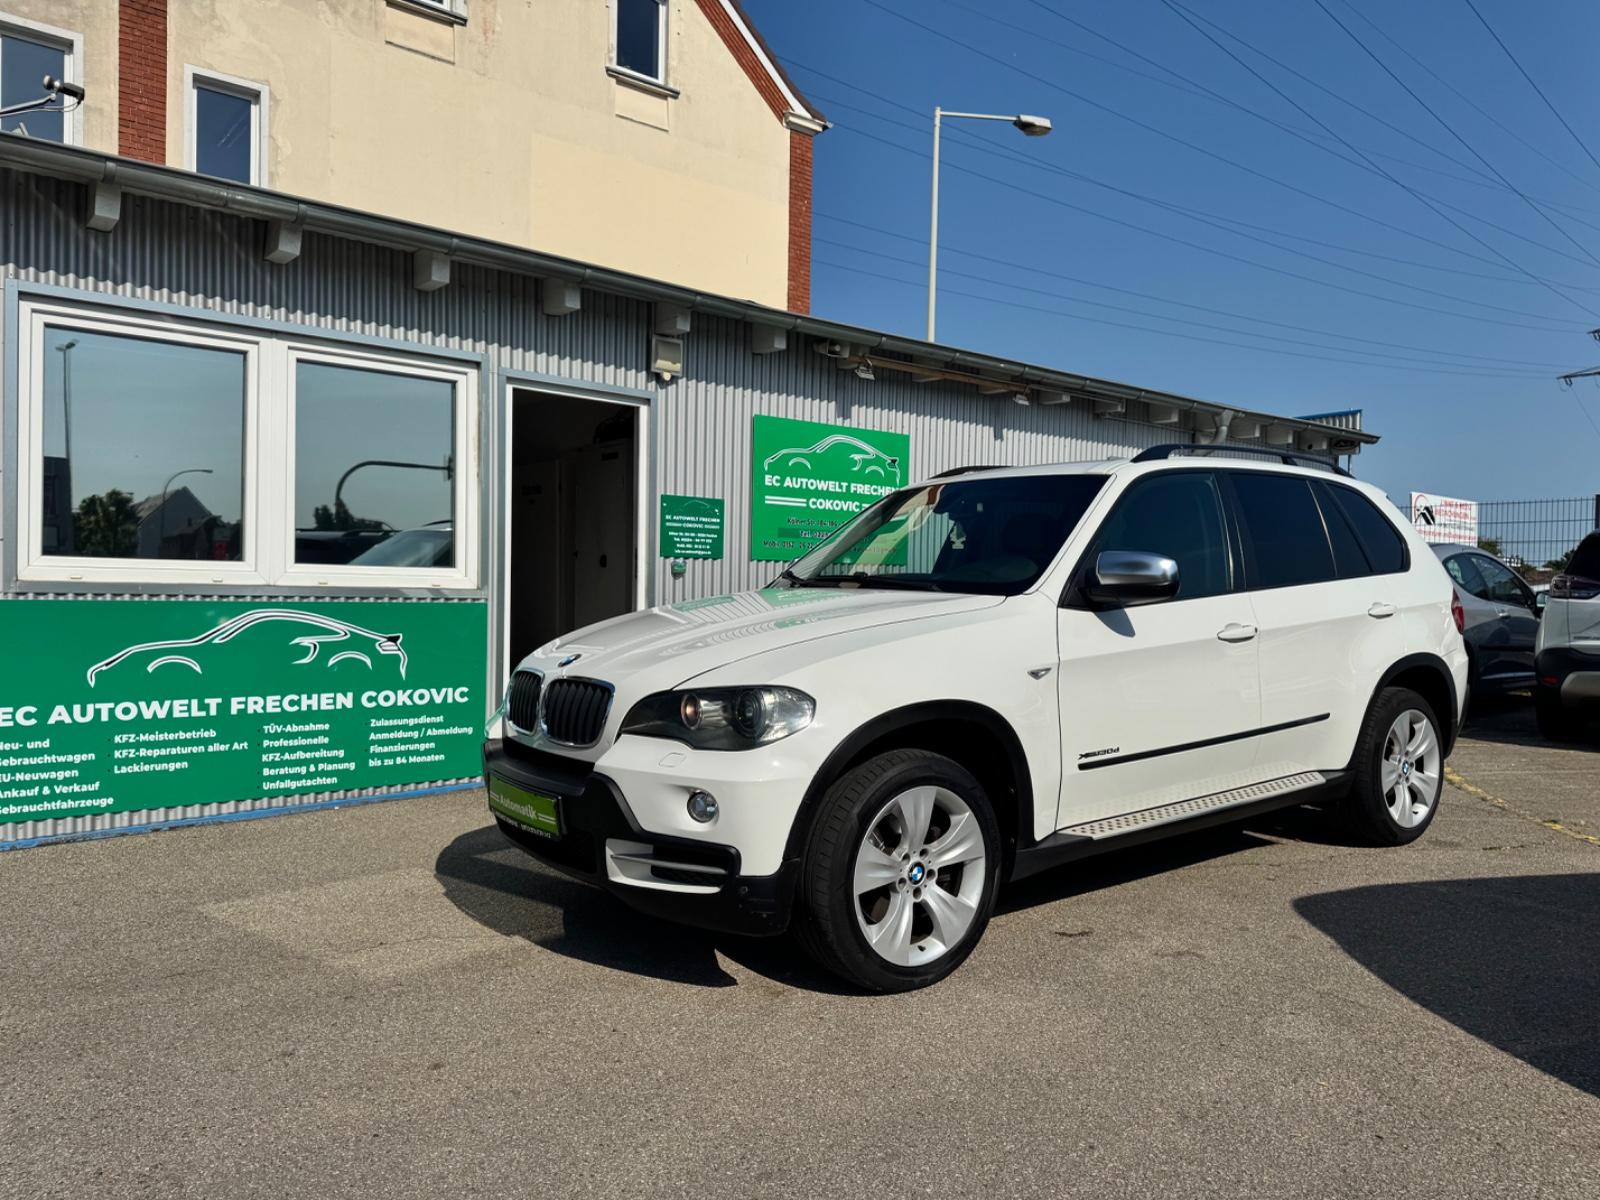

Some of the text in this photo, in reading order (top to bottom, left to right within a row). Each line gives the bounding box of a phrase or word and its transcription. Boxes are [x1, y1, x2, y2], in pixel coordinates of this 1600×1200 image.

[764, 475, 781, 487] EC
[784, 476, 848, 493] AUTOWELT
[809, 498, 860, 512] COKOVIC
[0, 686, 470, 727] EC AUTOWELT FRECHEN COKOVIC
[370, 714, 444, 727] Zulassungsdienst
[263, 723, 330, 734] TÜV-Abnahme
[369, 729, 419, 740] Anmeldung
[426, 726, 474, 736] Abmeldung
[114, 728, 217, 744] KFZ-Meisterbetrieb
[263, 736, 330, 748] Professionelle
[26, 738, 50, 749] und
[114, 741, 249, 759] KFZ-Reparaturen aller Art
[369, 741, 436, 754] Finanzierungen
[0, 752, 96, 767] ebrauchtwagen
[262, 748, 345, 762] KFZ-Aufbereitung
[368, 757, 382, 767] bis
[383, 758, 394, 766] zu
[408, 753, 446, 764] Monaten
[114, 761, 189, 774] Lackierungen
[262, 761, 356, 776] Beratung & Planung
[42, 786, 51, 795] &
[54, 781, 100, 795] Verkauf
[262, 776, 338, 790] Unfallgutachten
[0, 797, 114, 815] ebrauchtfahrzeuge
